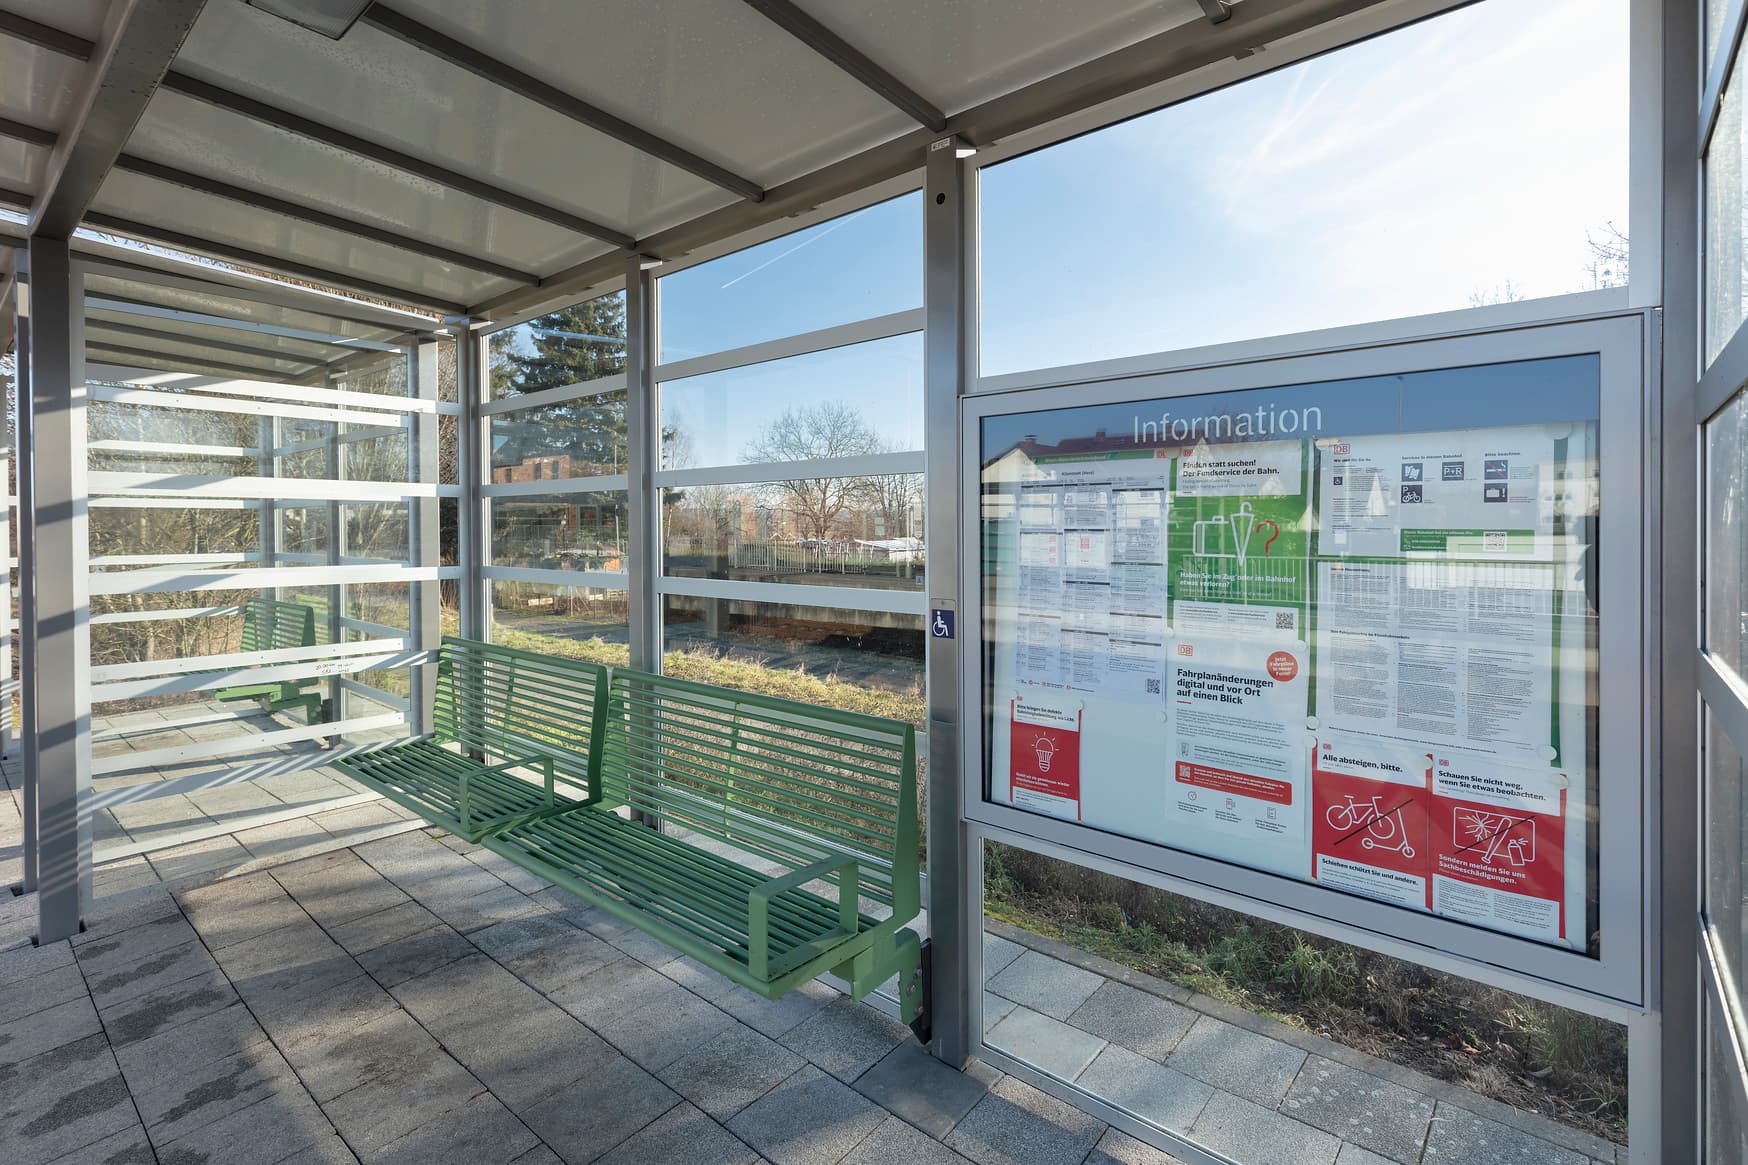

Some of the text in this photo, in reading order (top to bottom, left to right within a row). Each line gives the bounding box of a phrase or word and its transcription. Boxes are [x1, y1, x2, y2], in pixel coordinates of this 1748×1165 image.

[1134, 403, 1322, 443] Information
[1183, 461, 1207, 469] Finden
[1227, 459, 1256, 467] suchen!
[1183, 469, 1196, 477] Der
[1197, 468, 1242, 476] Fundservice
[1242, 468, 1256, 476] der
[1444, 468, 1462, 476] P+R
[1178, 645, 1192, 656] DB
[1177, 668, 1274, 688] Fahrplanänderungen
[1176, 688, 1243, 704] auf einen Blick
[1177, 679, 1205, 689] digital
[1207, 683, 1224, 692] und
[1244, 686, 1261, 696] Ort
[1322, 754, 1403, 772] Alle absteigen, bitte.
[1438, 770, 1470, 781] Schauen
[1470, 775, 1482, 783] Sie
[1484, 778, 1503, 787] nicht
[1472, 784, 1494, 793] etwas
[1496, 787, 1546, 800] beobachten.
[1322, 858, 1348, 869] Schieben
[1349, 865, 1370, 874] schützt
[1394, 876, 1418, 886] andere.
[1439, 854, 1468, 866] Sondern
[1469, 862, 1497, 872] melden
[1498, 868, 1510, 876] Sie
[1439, 861, 1516, 884] Sachbeschädigungen.
